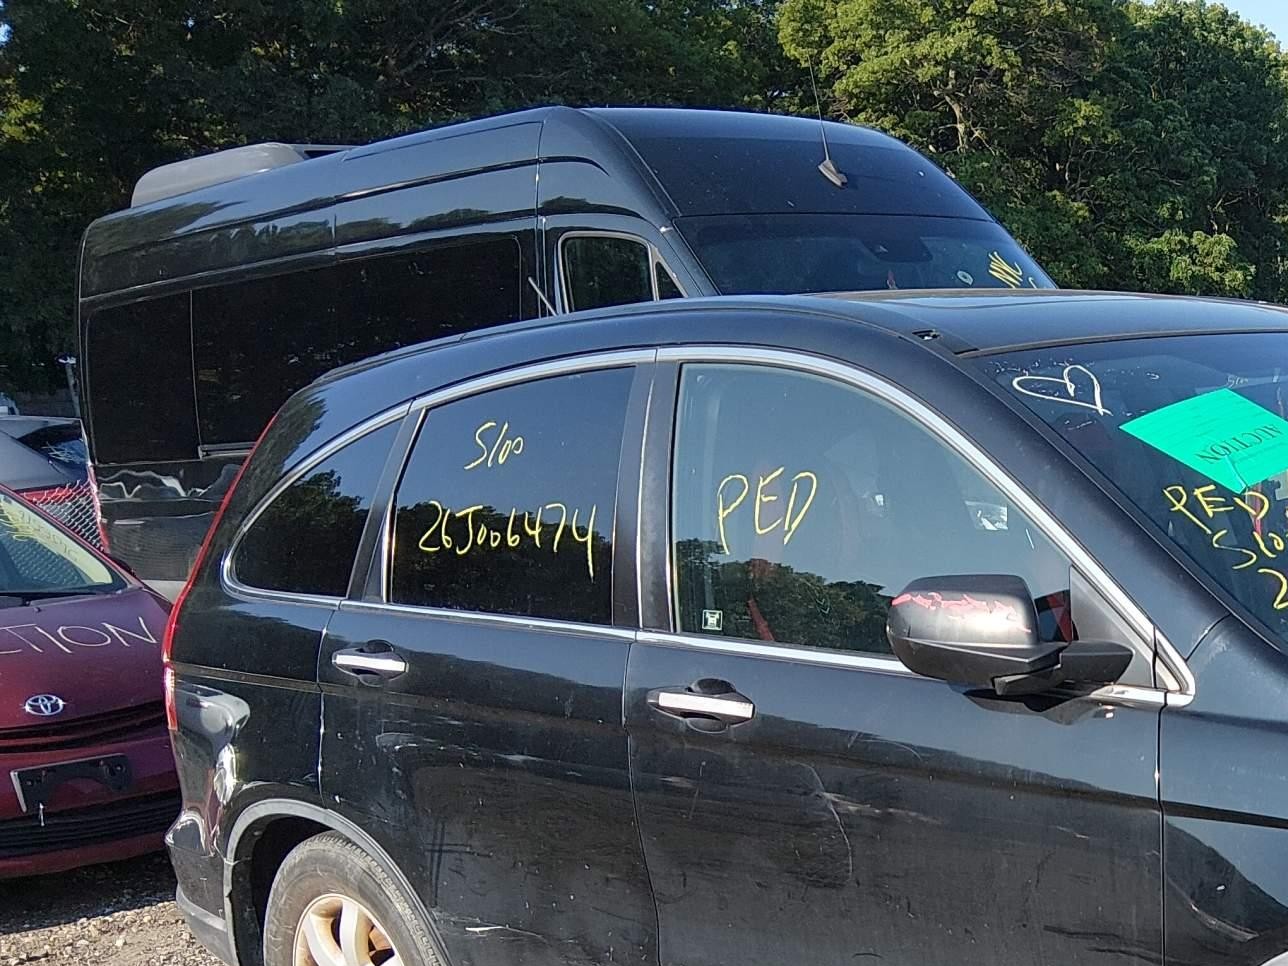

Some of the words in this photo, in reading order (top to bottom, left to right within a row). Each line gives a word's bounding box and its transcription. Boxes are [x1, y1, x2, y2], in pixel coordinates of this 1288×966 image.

[1195, 423, 1283, 465] AUCTION
[717, 466, 818, 556] PED
[1162, 484, 1270, 534] PED
